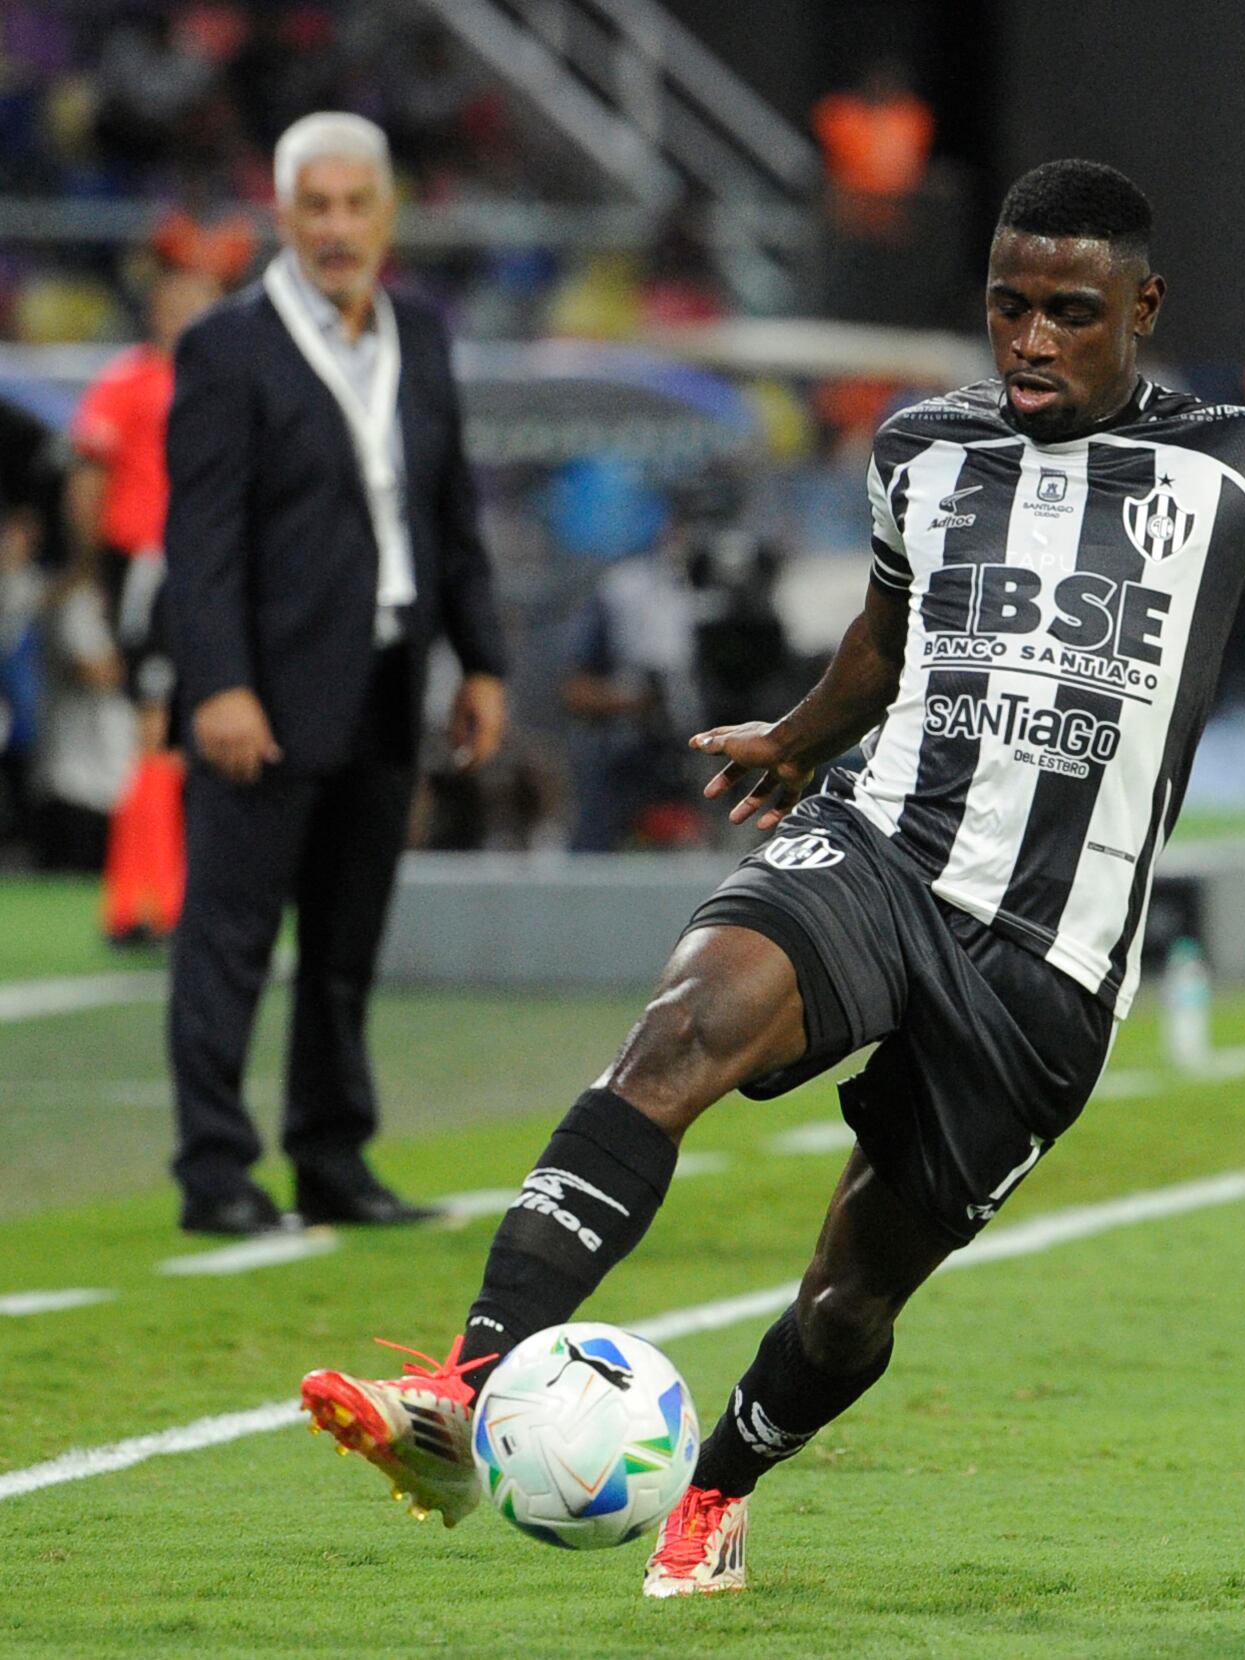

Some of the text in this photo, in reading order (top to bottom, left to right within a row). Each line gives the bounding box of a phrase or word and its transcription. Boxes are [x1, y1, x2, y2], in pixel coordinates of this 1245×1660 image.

[1023, 502, 1074, 513] SANTIAGO
[923, 636, 1158, 690] BANCO SANTIAGO
